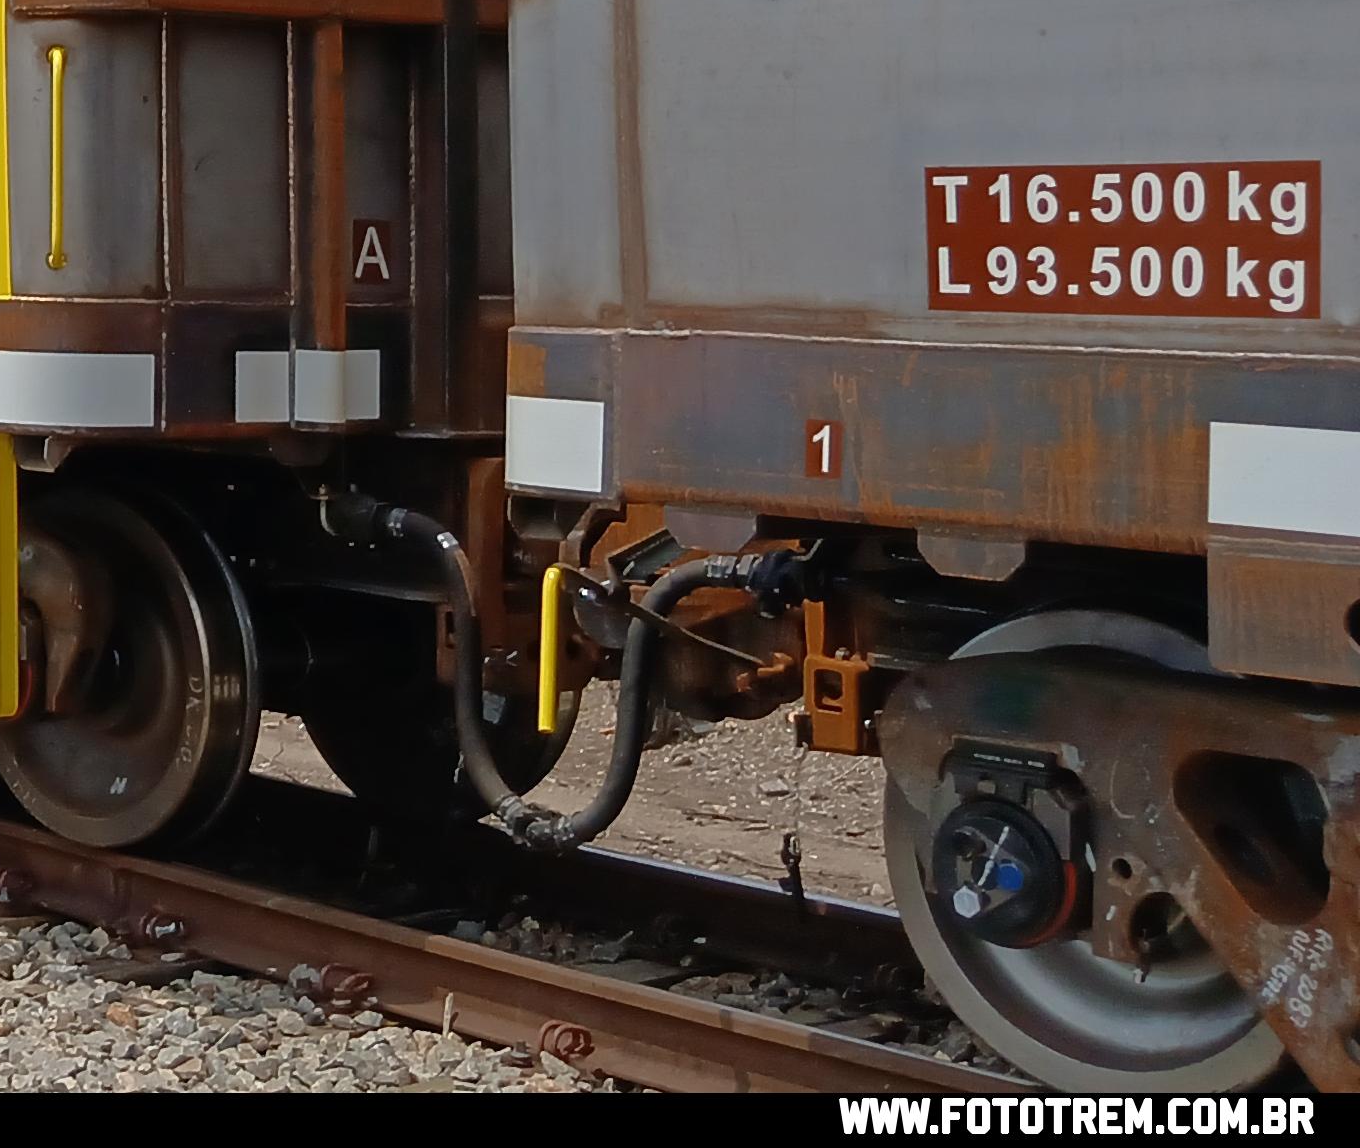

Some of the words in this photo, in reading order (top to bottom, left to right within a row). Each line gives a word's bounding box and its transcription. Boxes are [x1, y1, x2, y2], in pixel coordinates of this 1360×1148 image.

[932, 175, 969, 224] T
[987, 171, 1206, 224] 16.500
[1227, 170, 1308, 235] kg
[355, 226, 390, 279] A
[937, 246, 971, 295] L
[986, 246, 1205, 297] 93.500
[1225, 246, 1306, 312] kg
[812, 424, 831, 474] 1
